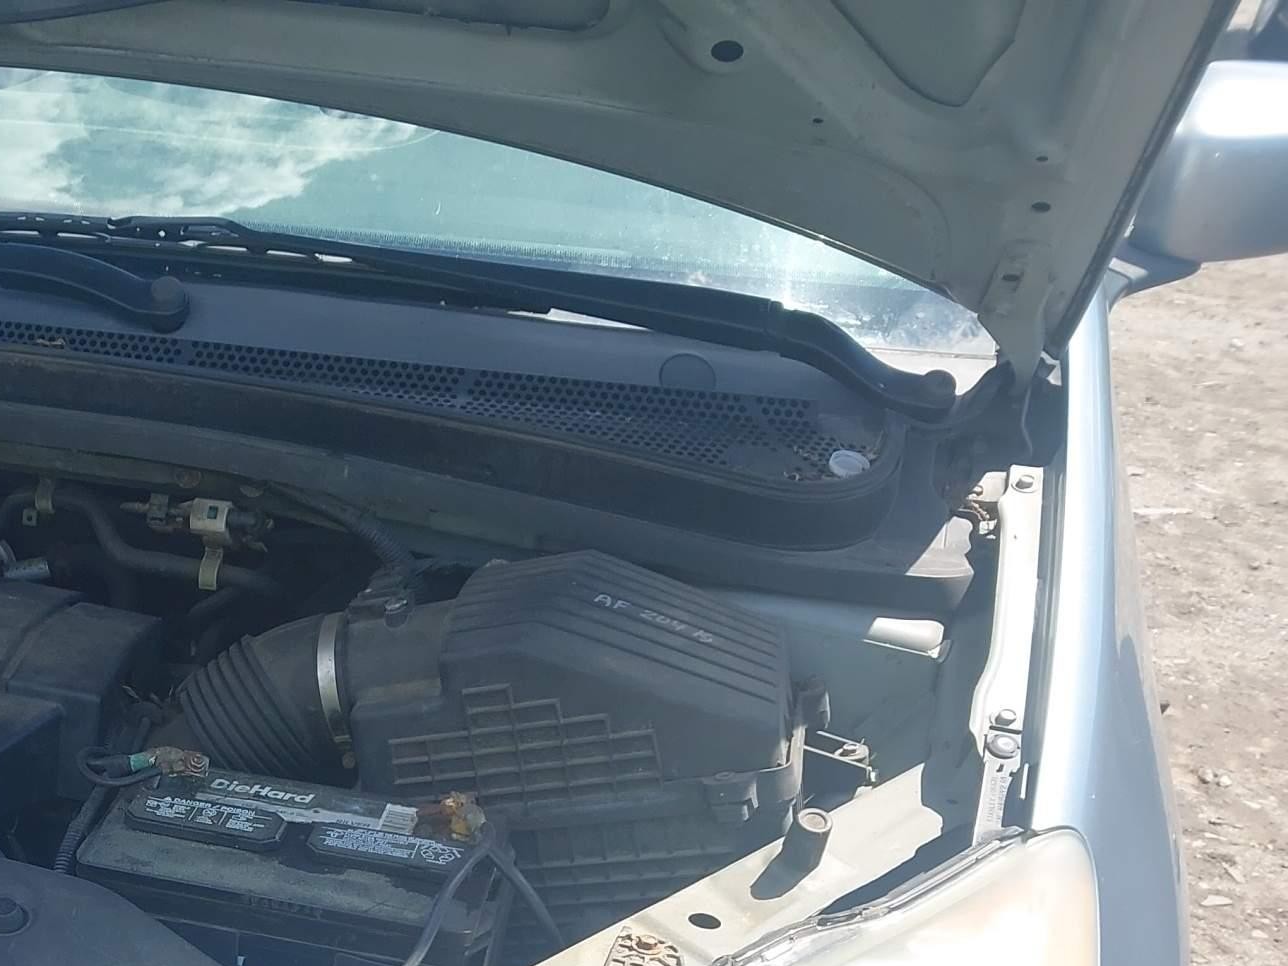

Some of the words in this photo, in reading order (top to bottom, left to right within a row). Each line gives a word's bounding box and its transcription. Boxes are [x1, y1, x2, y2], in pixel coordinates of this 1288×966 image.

[210, 778, 316, 804] DieHard
[174, 797, 212, 810] DANGER
[220, 805, 256, 817] POISON
